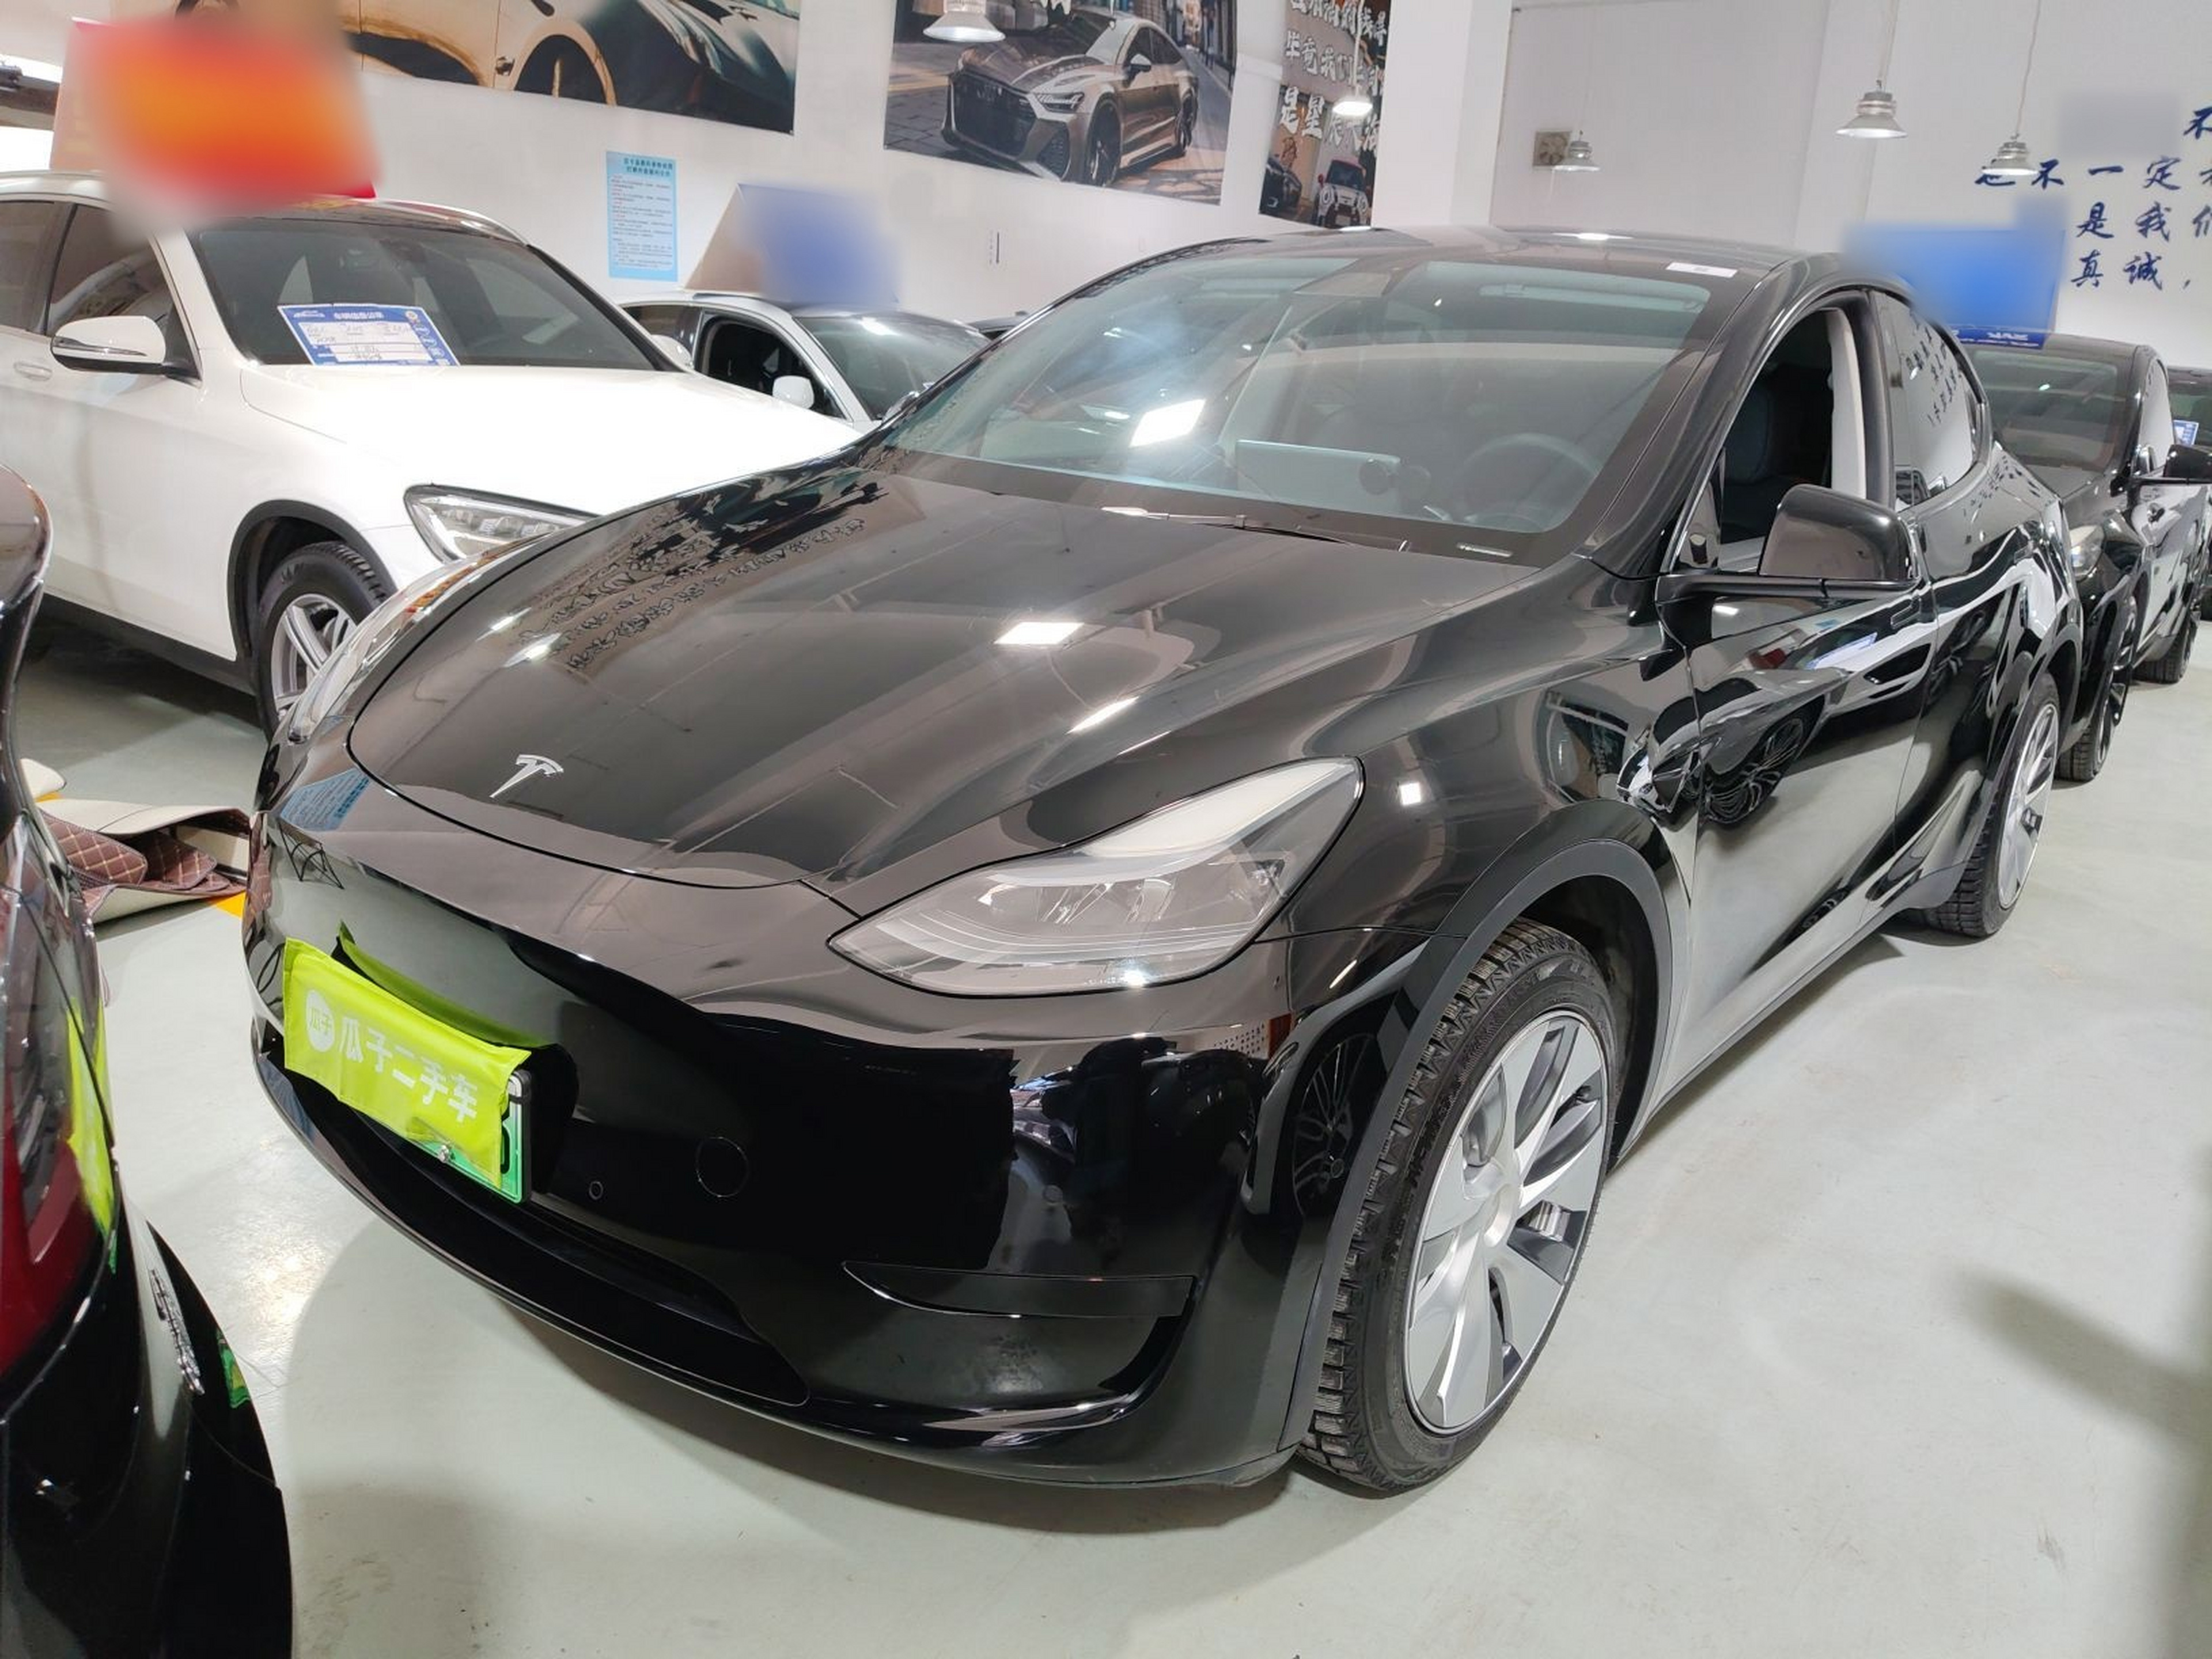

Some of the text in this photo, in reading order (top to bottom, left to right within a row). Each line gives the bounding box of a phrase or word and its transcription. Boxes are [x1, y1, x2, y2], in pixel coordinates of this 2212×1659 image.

[339, 1016, 479, 1124] 瓜子二手车
